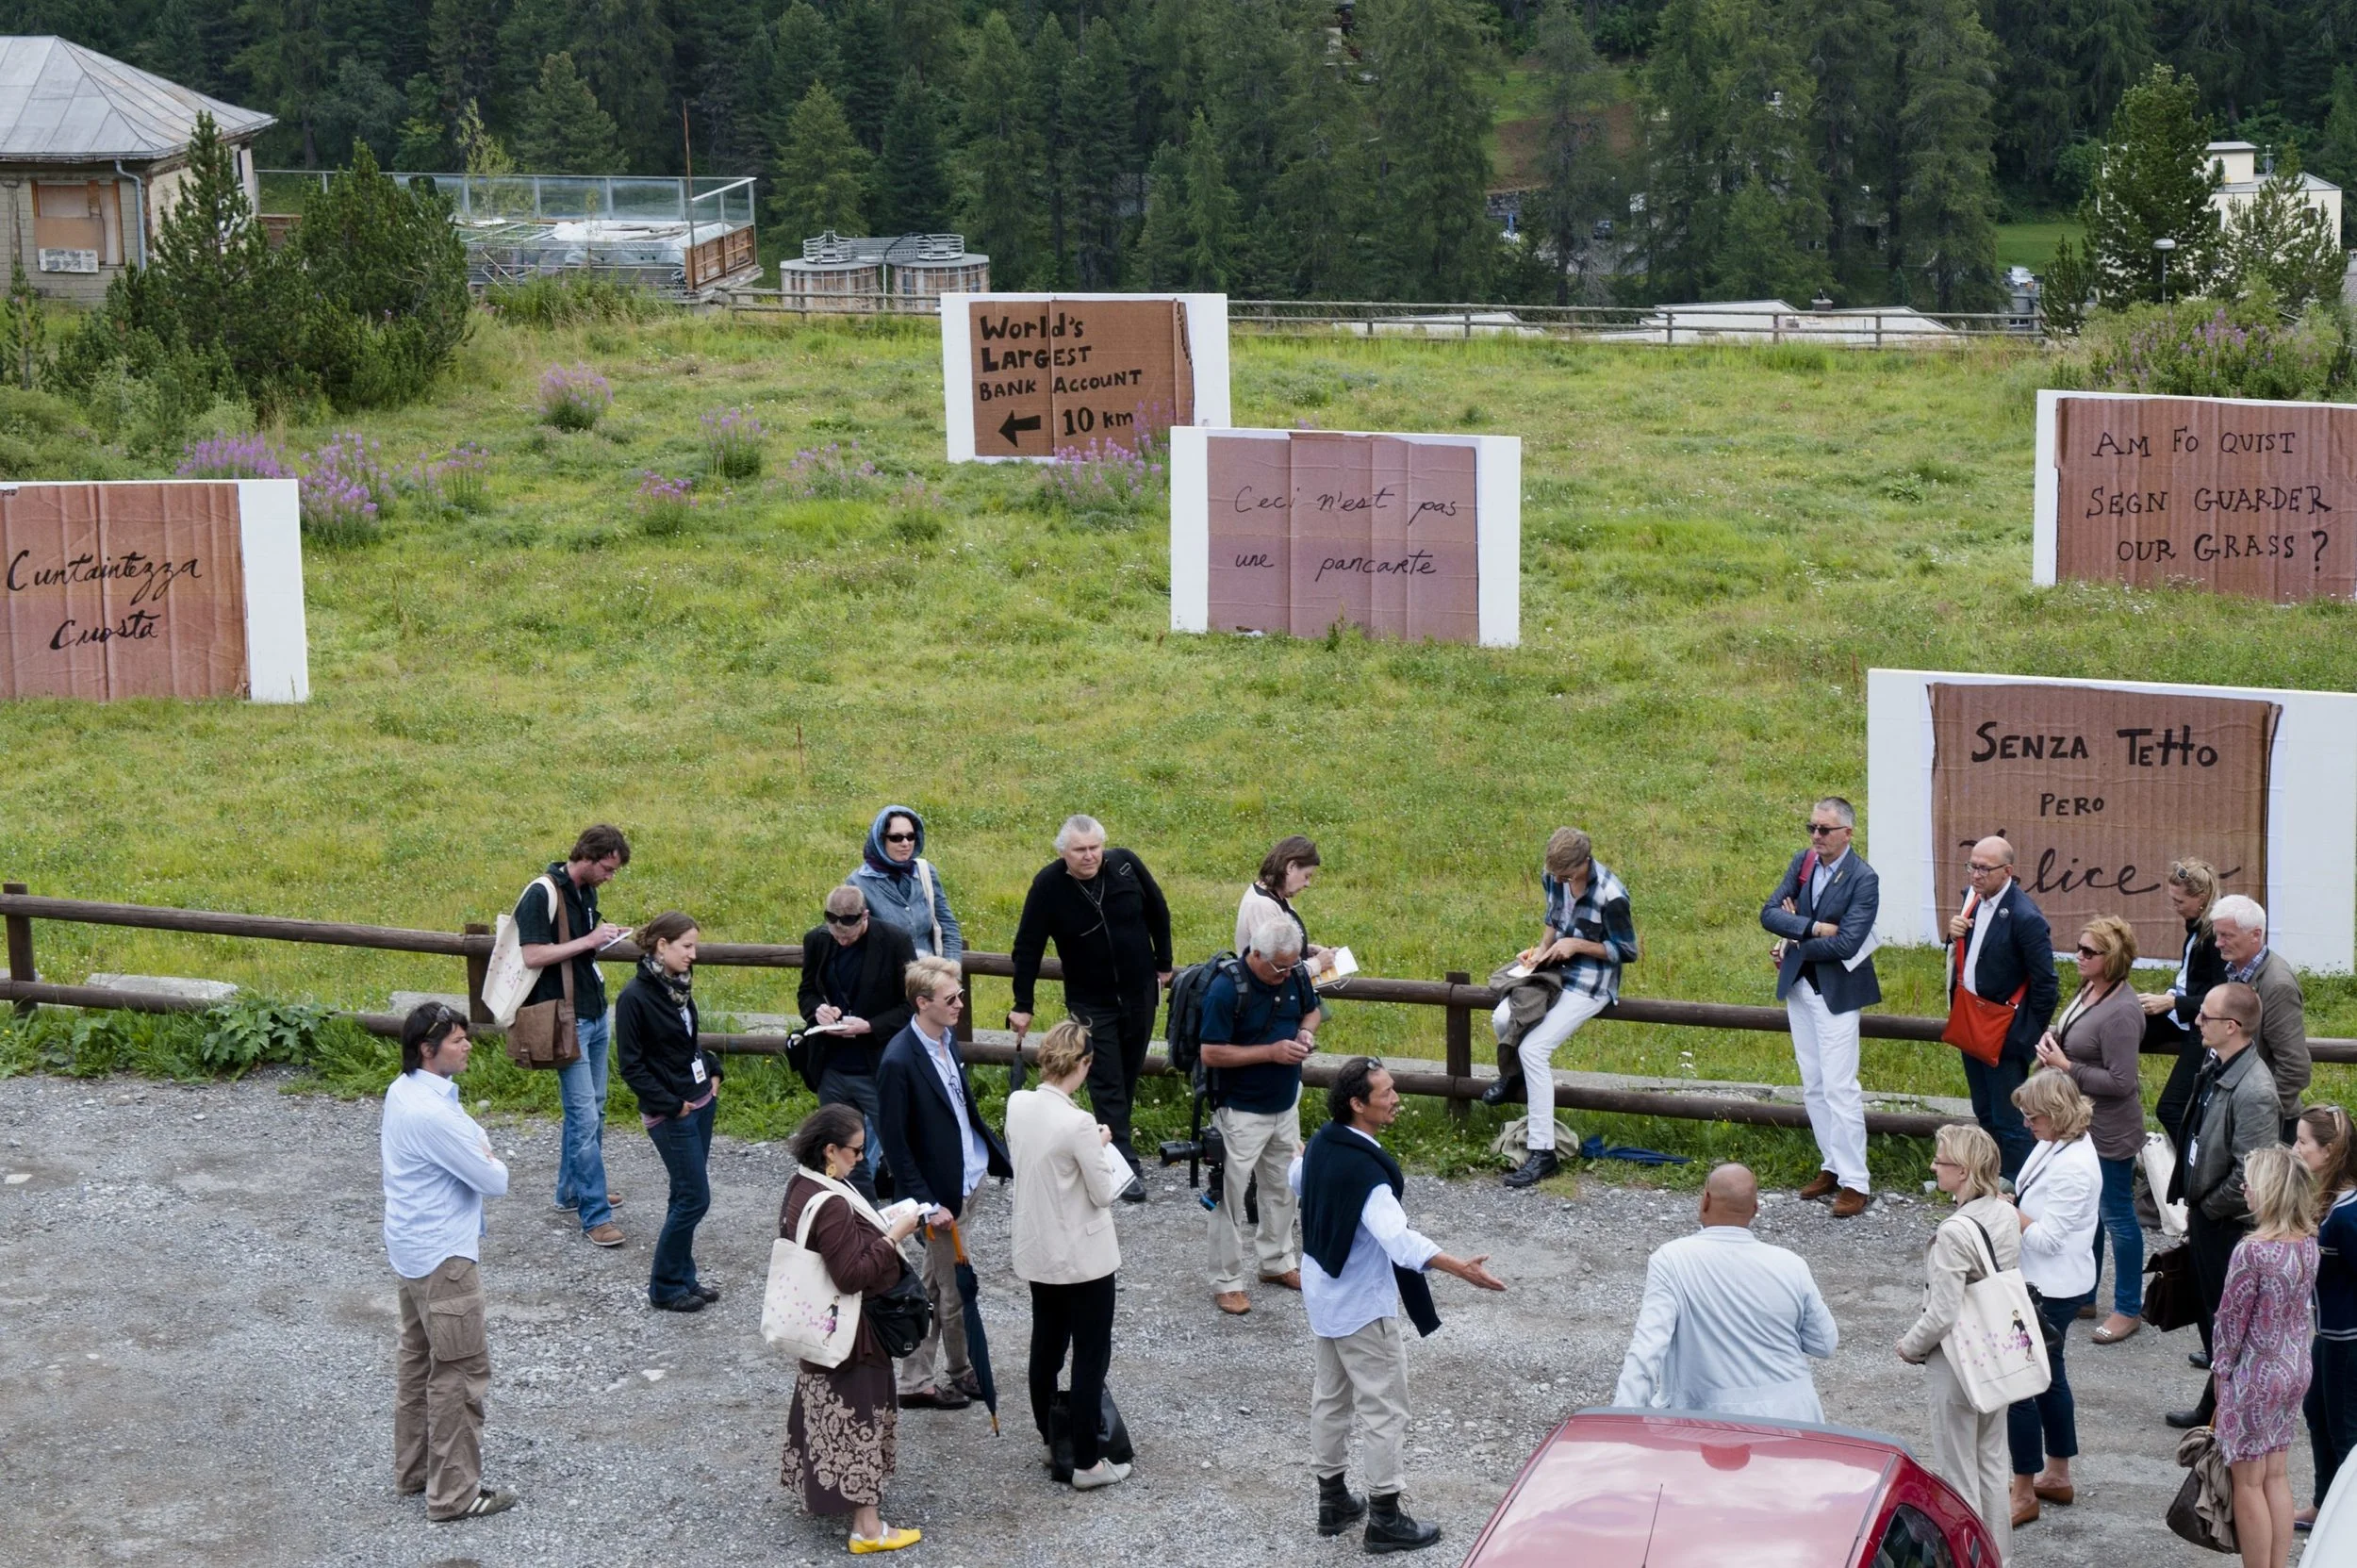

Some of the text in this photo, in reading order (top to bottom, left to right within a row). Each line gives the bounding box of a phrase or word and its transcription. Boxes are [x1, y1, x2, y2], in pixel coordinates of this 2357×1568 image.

[980, 312, 1084, 340] World's
[980, 369, 1142, 401] BANK ACCOUNT
[1063, 406, 1133, 437] 10 km
[2091, 432, 2151, 457] AM
[2220, 432, 2295, 454] QUIST
[1235, 486, 1457, 526] Ceci n'est pas
[2086, 486, 2332, 519] SEGN GUARDER
[1235, 553, 1274, 568] une
[2118, 538, 2176, 563] OUR
[7, 550, 202, 606] Cuntaintezza
[49, 609, 161, 651] Cuosta
[1971, 721, 2088, 763] SENZA
[2040, 793, 2104, 817] PERO
